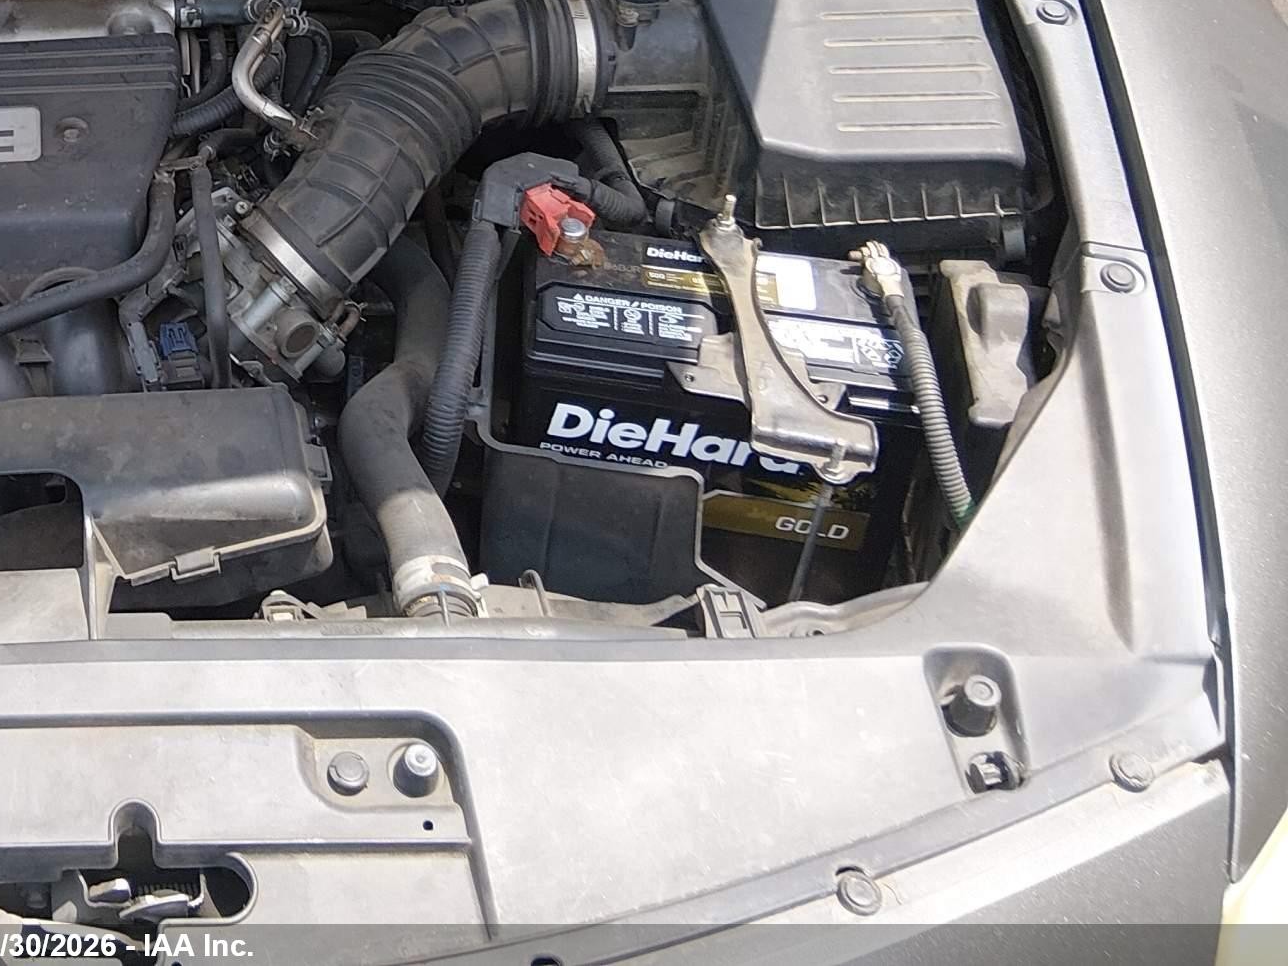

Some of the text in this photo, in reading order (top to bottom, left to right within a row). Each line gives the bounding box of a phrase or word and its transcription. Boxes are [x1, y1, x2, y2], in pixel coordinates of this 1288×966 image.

[646, 247, 706, 263] DieHar
[585, 294, 630, 308] DANGER
[641, 302, 683, 314] POISON
[539, 442, 669, 468] POWER AHEAD
